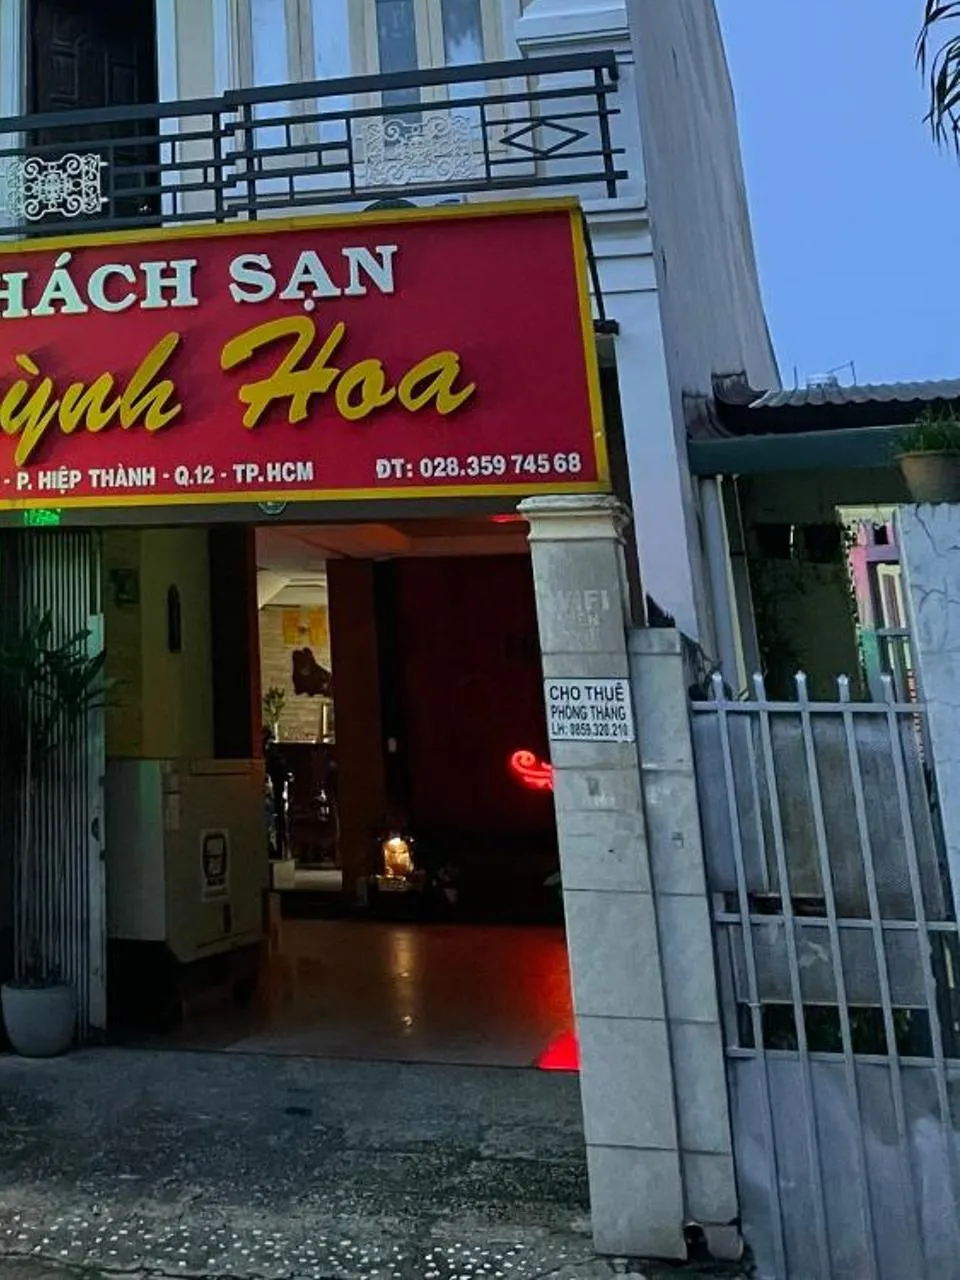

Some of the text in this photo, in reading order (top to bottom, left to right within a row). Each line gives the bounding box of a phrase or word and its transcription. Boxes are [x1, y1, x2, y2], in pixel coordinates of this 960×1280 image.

[228, 245, 398, 312] SẠN
[221, 315, 476, 429] Hoa
[38, 465, 82, 495] HIỆP
[89, 462, 156, 488] THÀNH
[174, 465, 215, 486] Q.12
[232, 461, 314, 483] TP.HCM
[376, 458, 413, 479] ĐT:
[550, 681, 625, 701] CHO THUÊ
